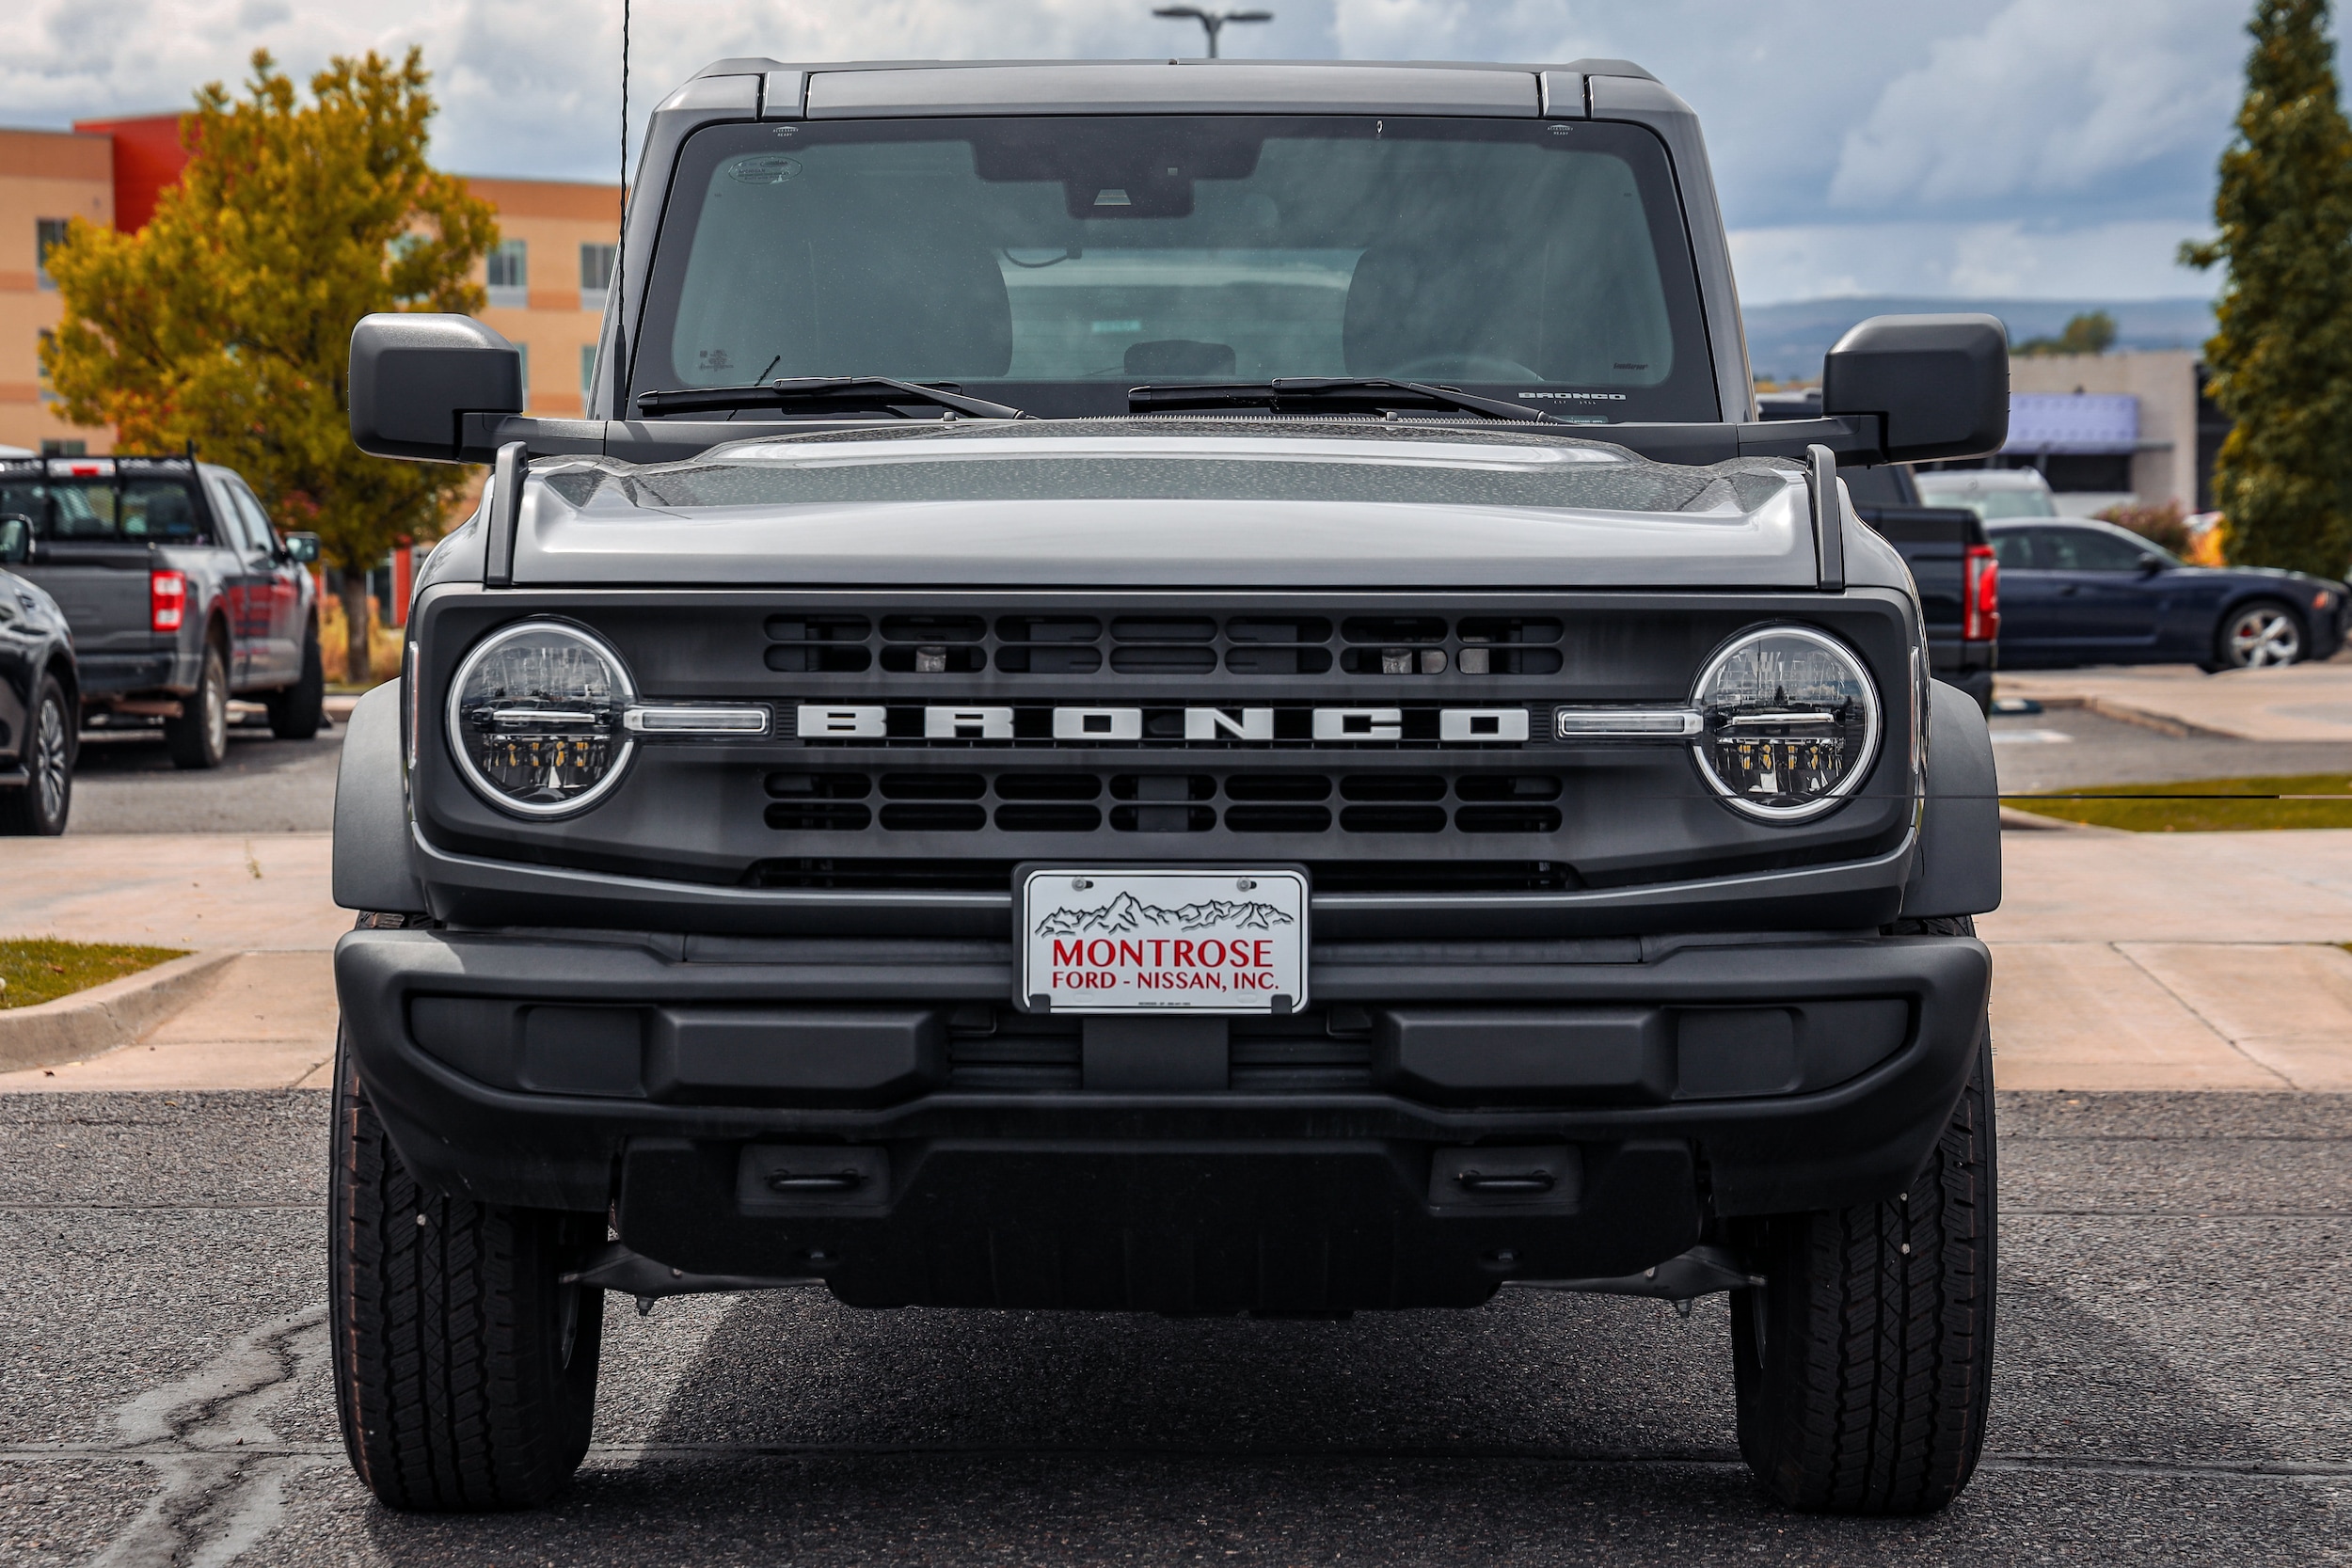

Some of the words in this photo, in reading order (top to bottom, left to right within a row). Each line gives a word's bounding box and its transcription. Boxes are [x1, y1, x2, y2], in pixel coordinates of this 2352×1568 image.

[1518, 392, 1627, 401] BRONCO
[797, 705, 1530, 741] BRONCO
[1052, 939, 1274, 968] MONTROSE
[1052, 972, 1116, 989] FORD
[1137, 972, 1227, 992] NISSAN,
[1233, 972, 1279, 990] INC.
